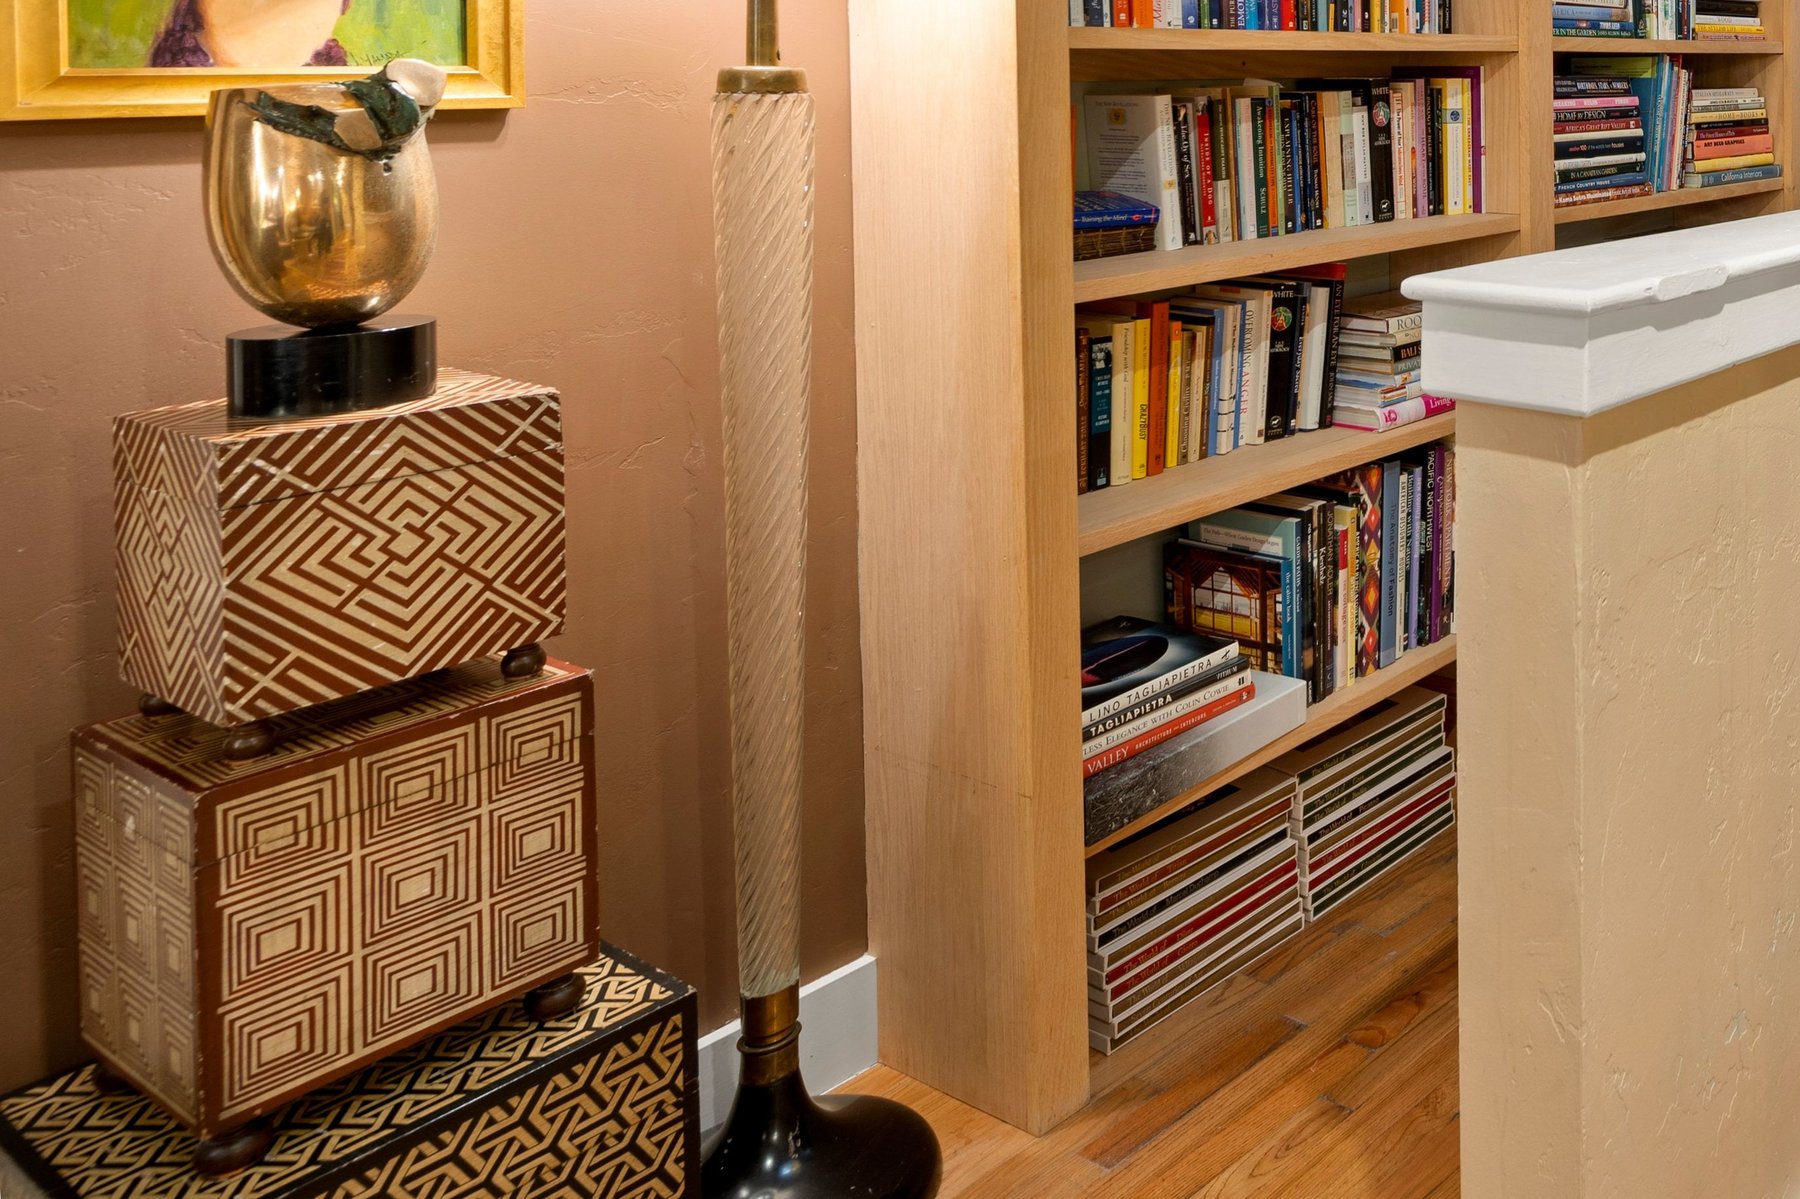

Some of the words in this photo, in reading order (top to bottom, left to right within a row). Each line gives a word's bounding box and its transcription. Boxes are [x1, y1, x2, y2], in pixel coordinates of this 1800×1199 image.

[1371, 87, 1389, 96] WHITE
[1255, 106, 1264, 145] Awakening
[1311, 120, 1318, 129] OF
[1557, 111, 1578, 121] HOME
[1584, 110, 1606, 120] DESIGN
[1181, 153, 1189, 163] of
[1283, 118, 1293, 171] EXPLAINING
[1205, 165, 1211, 174] OF
[1576, 181, 1596, 189] COUNTRY
[1596, 179, 1611, 187] HOUSE
[1721, 171, 1743, 182] California
[1743, 170, 1763, 179] Interiors
[1259, 187, 1267, 214] SCHULZ
[1286, 173, 1294, 205] HITLER
[1081, 215, 1103, 223] Training
[1272, 290, 1294, 298] WHITE
[1122, 327, 1130, 355] Friendship
[1242, 310, 1254, 370] OVERCOMING
[1295, 336, 1303, 368] Everyday
[1400, 346, 1416, 359] BALI
[1239, 370, 1249, 416] ANGER
[1293, 370, 1301, 394] Sacred
[1430, 397, 1452, 409] Living
[1181, 416, 1190, 453] Choosing
[1426, 450, 1436, 489] PACIFIC
[1406, 474, 1415, 507] Building
[1444, 488, 1452, 517] YORK
[1406, 511, 1414, 529] with
[1425, 491, 1434, 552] NORTHWEST
[1326, 511, 1334, 561] JONATHAN
[1387, 522, 1397, 565] Anatomy
[1318, 546, 1326, 586] Kienholz
[1405, 539, 1413, 570] Nature
[1443, 520, 1452, 591] APARTMENTS
[1326, 565, 1334, 596] ADLER
[1388, 568, 1396, 577] of
[1387, 579, 1396, 616] Fashion
[1089, 700, 1121, 723] LINO
[1126, 659, 1213, 702] TAGLIAPIETRA
[1089, 694, 1173, 737] TAGLIAPIETRA
[1105, 720, 1148, 745] ELEGANCE
[1150, 711, 1173, 725] WITH
[1175, 698, 1201, 714] COLIN
[1203, 685, 1230, 701] COWIE
[1087, 746, 1129, 774] VALLEY
[1135, 728, 1172, 750] ARCHITECTURE
[1180, 713, 1207, 729] INTERIORS
[1128, 906, 1150, 925] World
